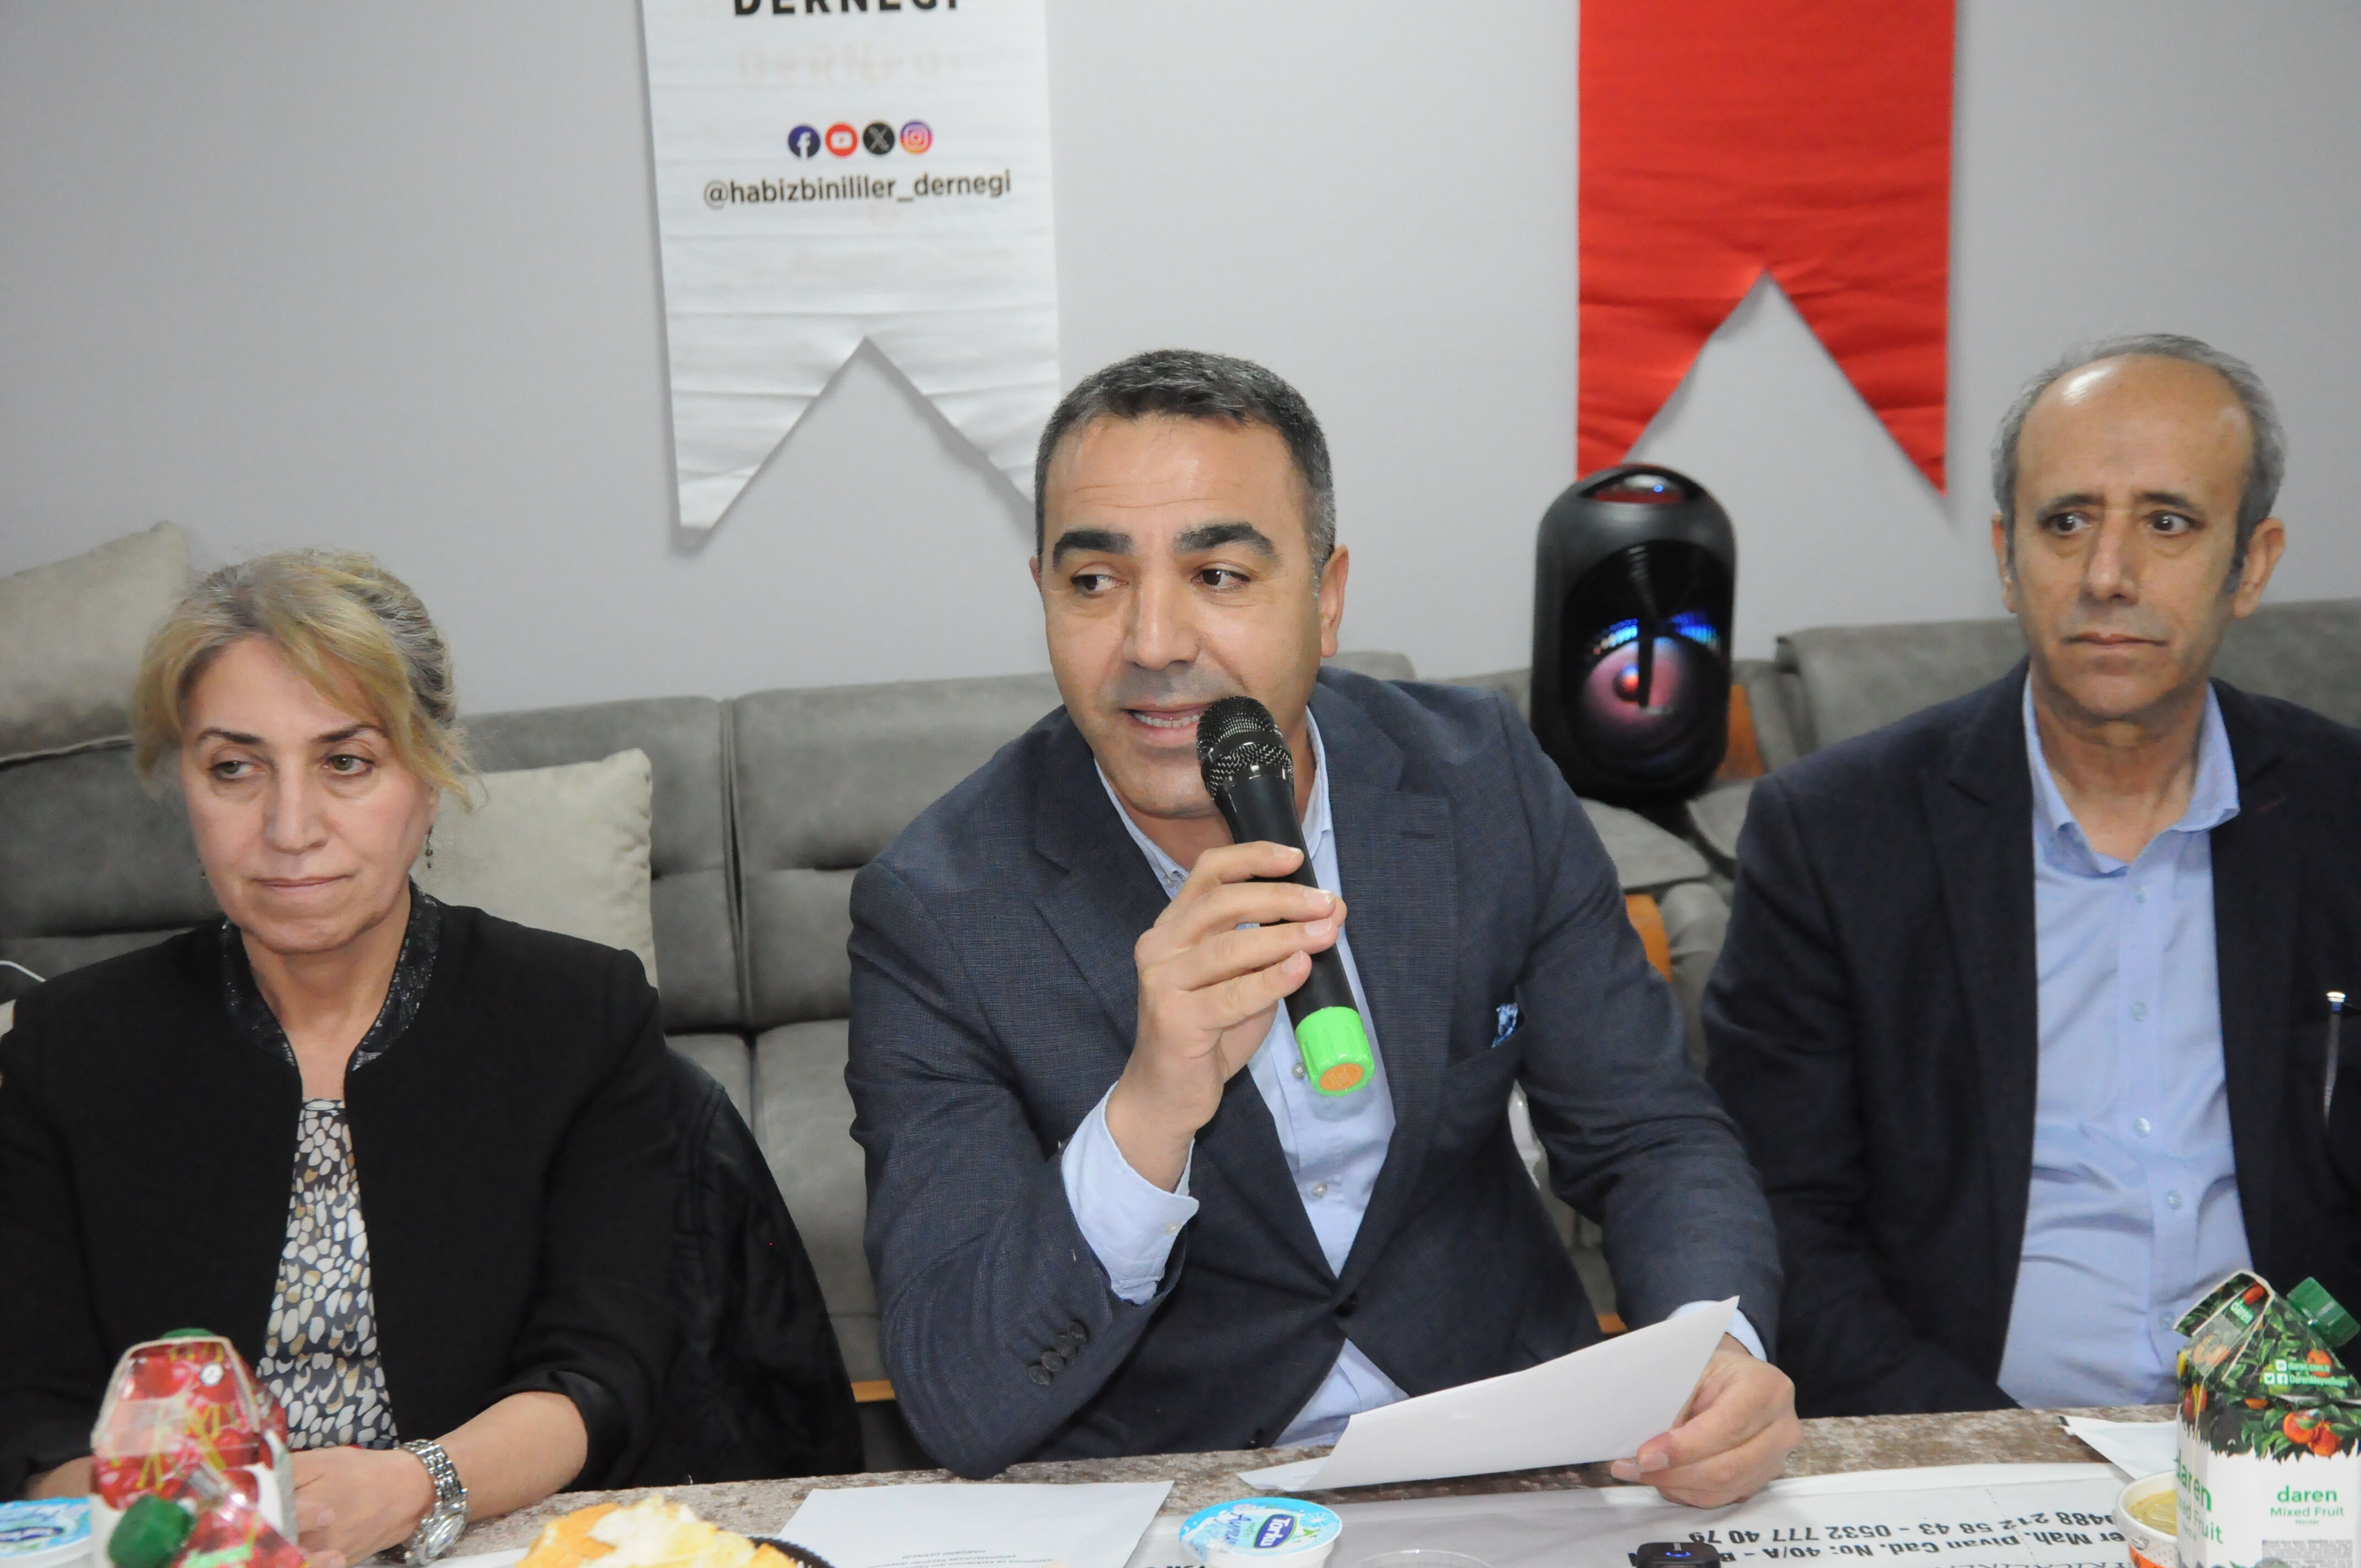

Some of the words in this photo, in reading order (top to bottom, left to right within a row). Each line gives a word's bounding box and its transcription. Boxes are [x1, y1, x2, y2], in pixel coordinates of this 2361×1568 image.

[2276, 1485, 2338, 1504] daren
[2270, 1506, 2311, 1517] Mixed
[2314, 1506, 2345, 1517] Fruit
[1772, 1527, 1820, 1542] 777
[1824, 1524, 1892, 1540] 0532
[1918, 1523, 1950, 1535] 43
[1959, 1523, 1994, 1534] 58
[1728, 1529, 1760, 1544] 40
[1945, 1535, 2021, 1550] Divan
[2024, 1531, 2094, 1545] Mah.
[1761, 1545, 1821, 1559] 40/A
[1830, 1544, 1872, 1557] No:
[1880, 1541, 1940, 1555] Cad.
